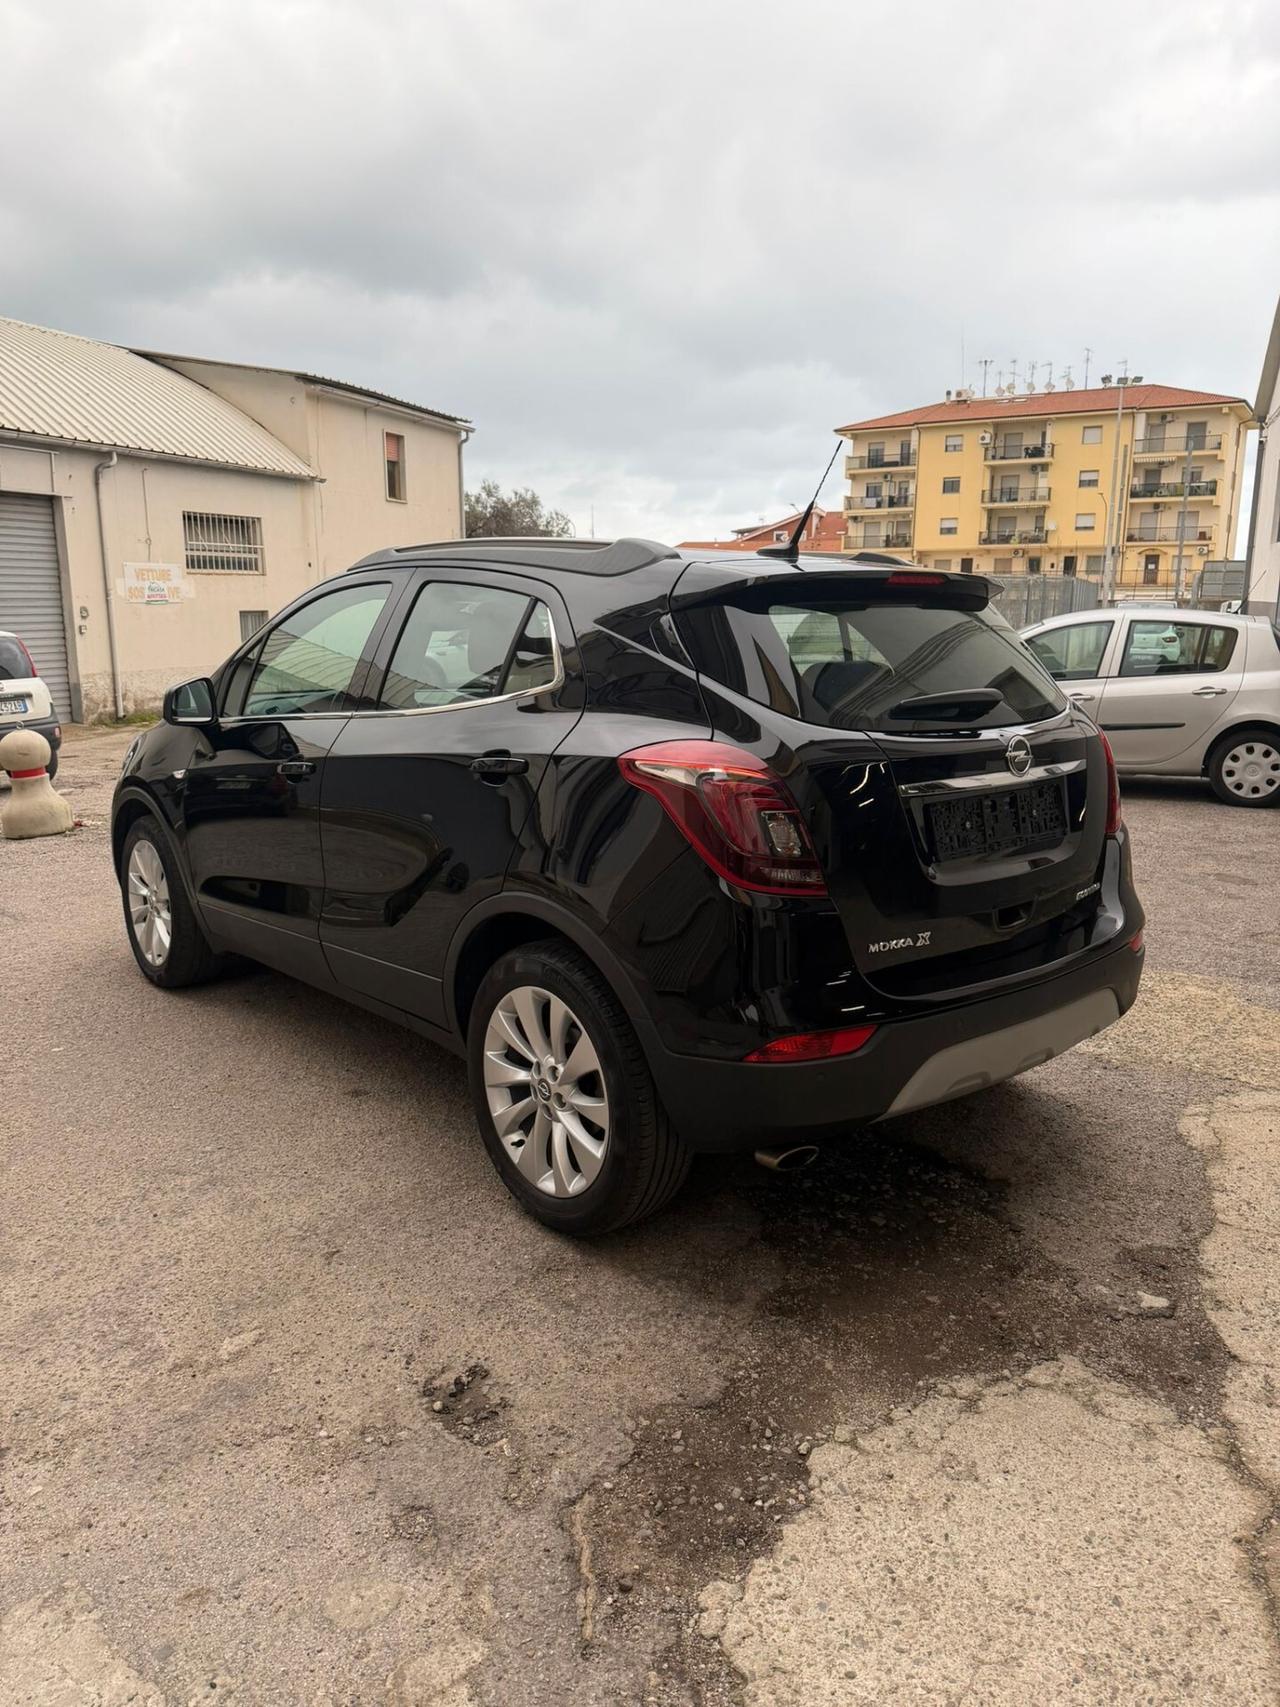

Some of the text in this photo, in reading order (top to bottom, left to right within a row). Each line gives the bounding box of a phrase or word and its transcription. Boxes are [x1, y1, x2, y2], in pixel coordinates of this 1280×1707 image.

[134, 567, 172, 581] VETTURE
[868, 931, 931, 953] MOKKA X
